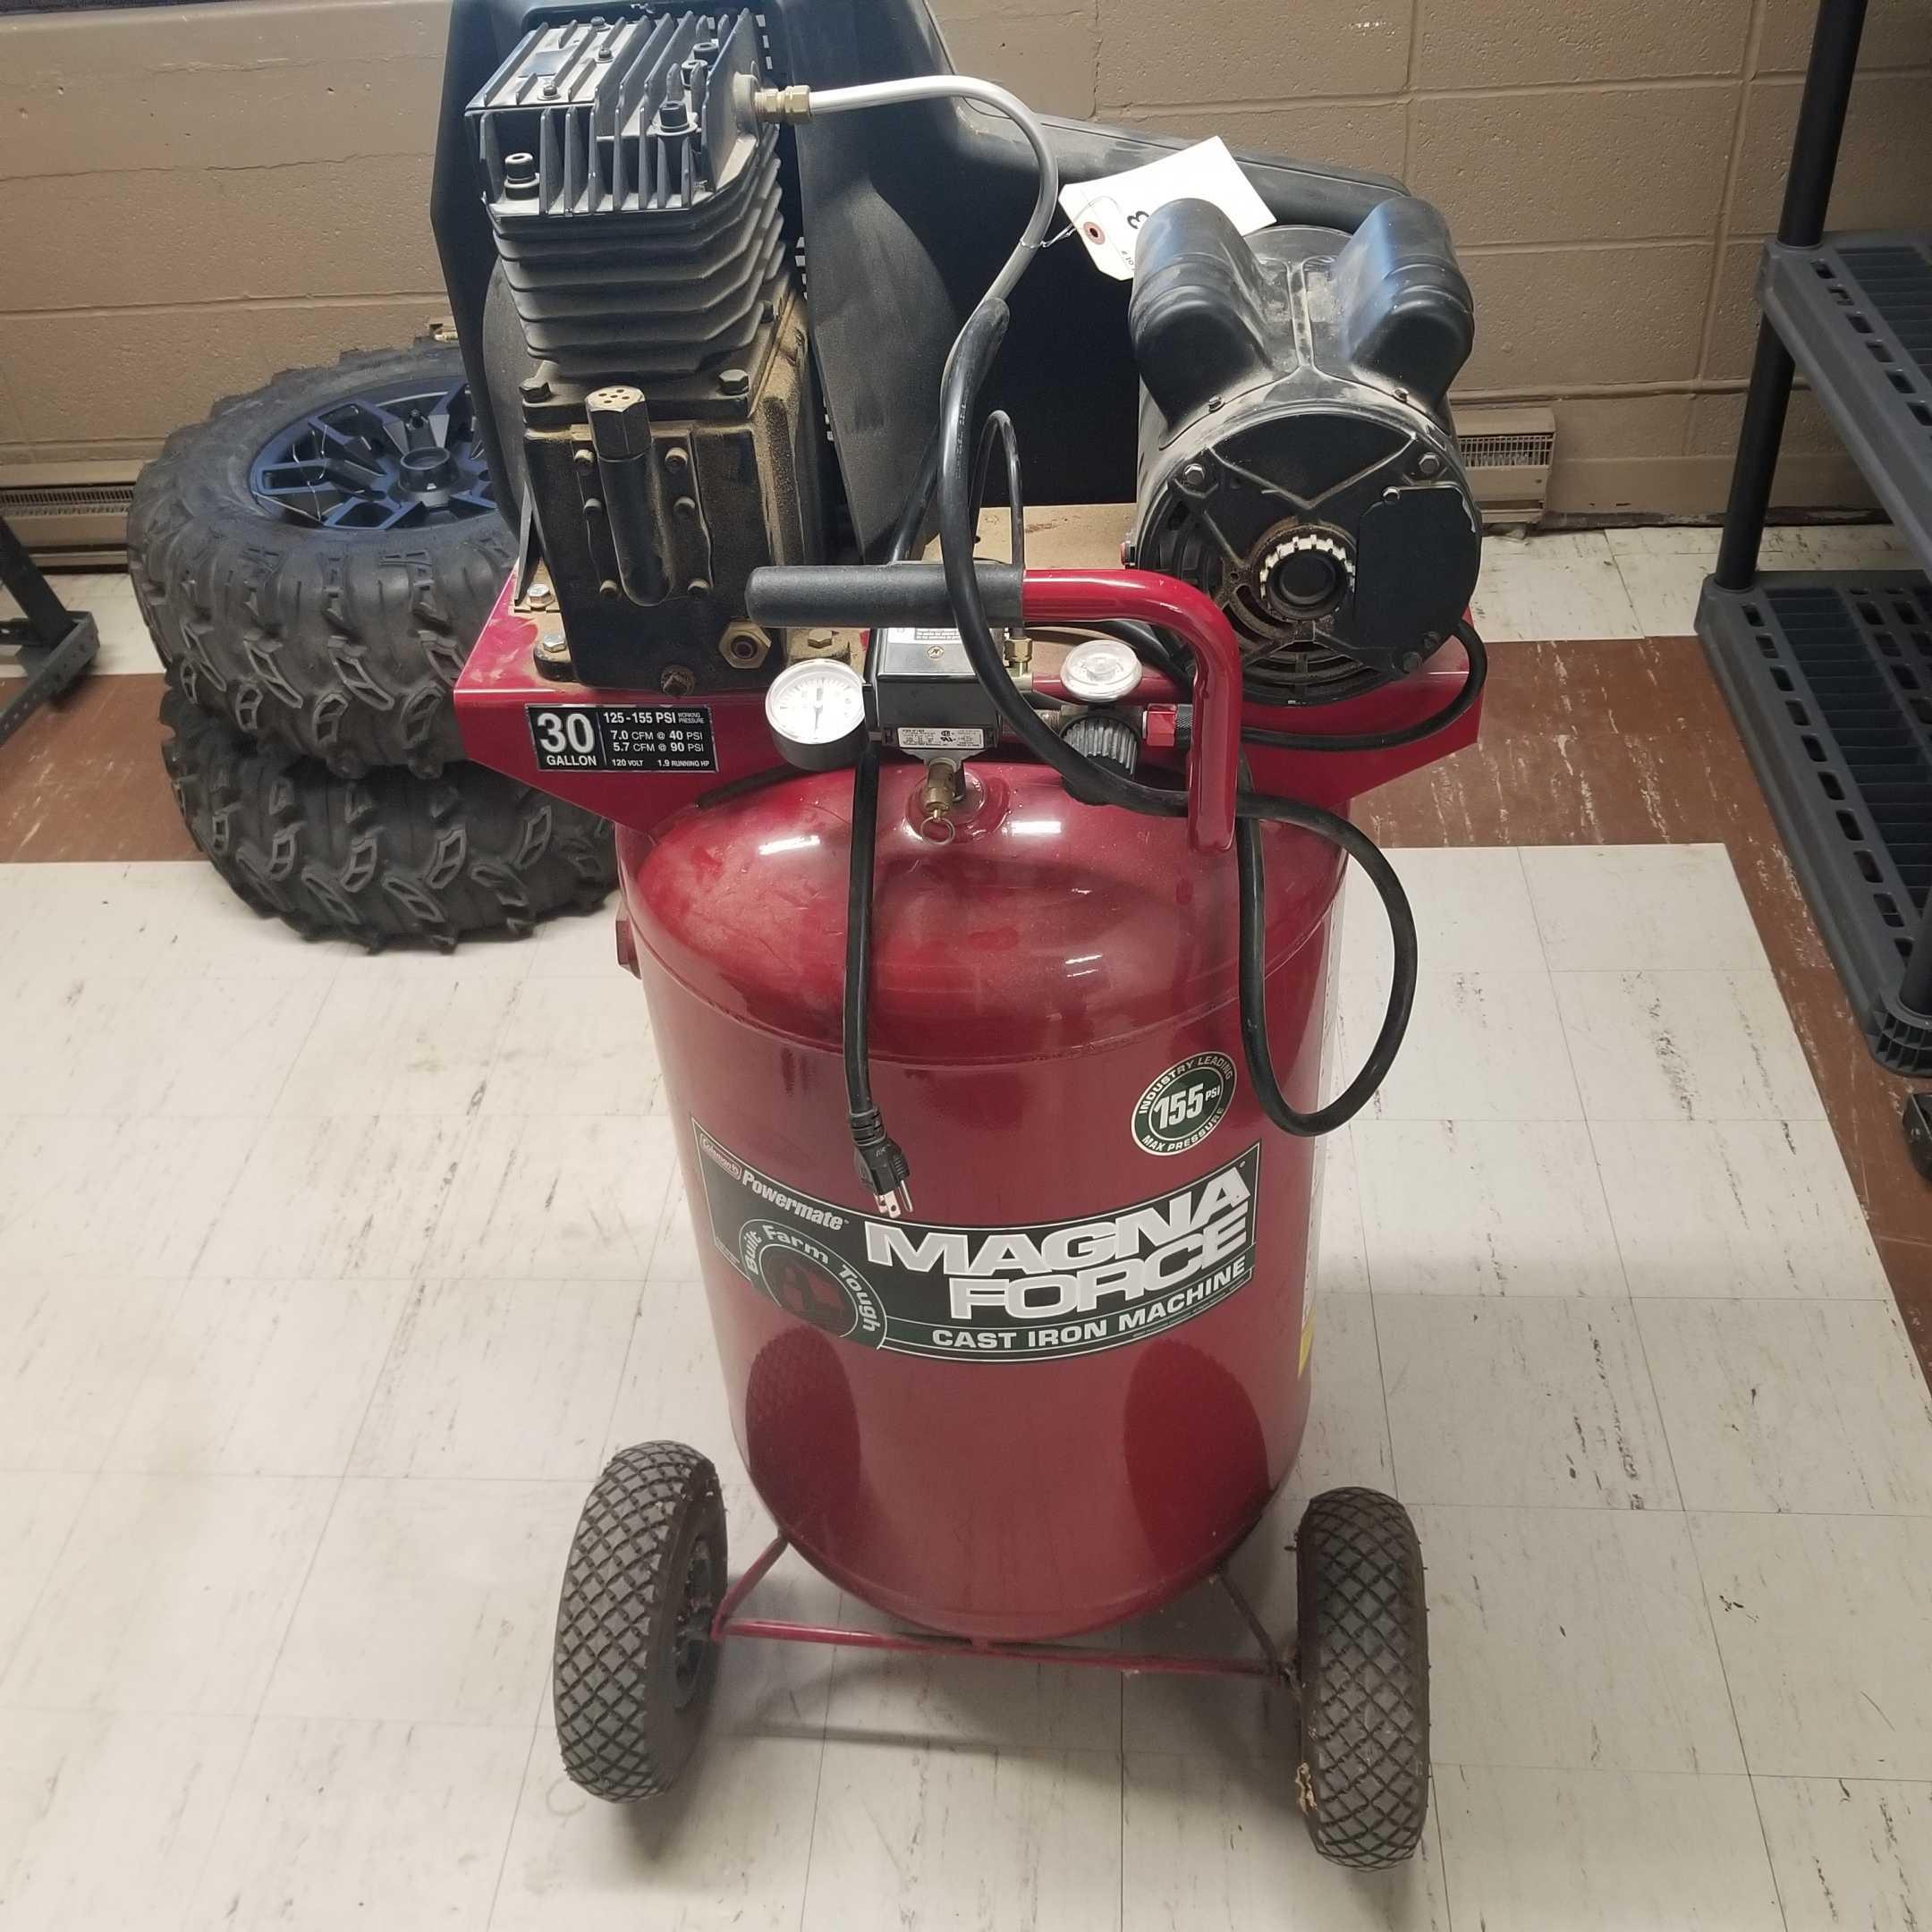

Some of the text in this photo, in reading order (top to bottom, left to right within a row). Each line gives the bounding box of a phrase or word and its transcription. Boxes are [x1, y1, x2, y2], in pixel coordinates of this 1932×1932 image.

[537, 712, 596, 754] 30
[610, 730, 703, 740] 7.0 CFM @ 40 PSI
[656, 712, 676, 724] PSI
[547, 755, 597, 767] GALLON
[611, 758, 626, 767] 120
[613, 742, 704, 752] 5.7 CFM @ 90 PSI
[1139, 1055, 1233, 1114] INDUSTRY LEADING
[1153, 1082, 1221, 1130] 155 PSI
[1141, 1107, 1224, 1152] MAX PRESSURE
[741, 1169, 843, 1232] Powermate
[864, 1165, 1250, 1276] MAGNA
[743, 1230, 762, 1275] Built
[762, 1224, 829, 1265] Farm
[837, 1264, 881, 1332] Tough
[949, 1200, 1249, 1319] FORCE
[932, 1330, 1017, 1349] CAST
[1028, 1319, 1107, 1348] IRON
[1118, 1255, 1247, 1332] MACHINE
